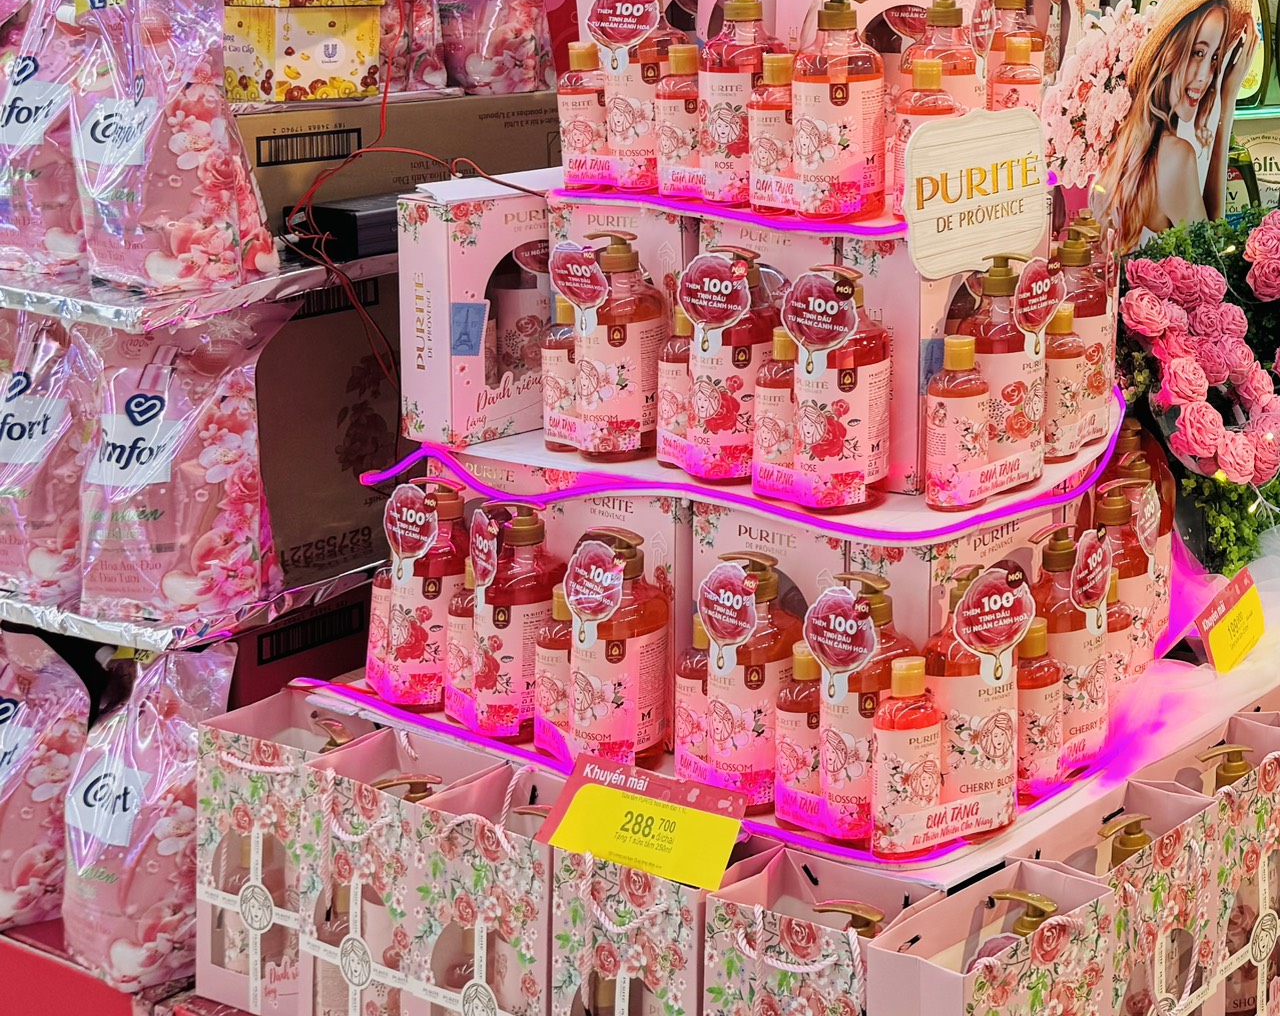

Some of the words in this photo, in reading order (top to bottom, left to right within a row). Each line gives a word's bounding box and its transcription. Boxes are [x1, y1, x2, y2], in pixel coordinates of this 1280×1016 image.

[615, 2, 654, 16] 100%
[228, 44, 241, 53] Cao
[242, 44, 255, 54] Cấp
[619, 149, 655, 158] BLOSSOM
[714, 162, 735, 170] ROSE
[392, 175, 409, 185] Đào
[411, 173, 427, 182] Anh
[914, 150, 1041, 211] PURITÉ
[936, 215, 953, 233] DE
[702, 277, 742, 294] 100%
[727, 303, 742, 311] HOA
[807, 296, 849, 315] 100%
[833, 324, 849, 333] HOA
[477, 377, 514, 414] Dành
[465, 412, 488, 432] tặng
[694, 436, 711, 446] ROSE
[800, 463, 817, 472] ROSE
[401, 507, 434, 526] 100%
[737, 523, 797, 548] PURITÉ
[1007, 571, 1023, 582] MỚI
[717, 588, 751, 610] 100%
[981, 589, 1024, 613] 100%
[829, 614, 867, 635] 100%
[1011, 613, 1029, 626] HOA
[1202, 610, 1218, 632] Khuyến
[854, 644, 868, 654] HOA
[575, 732, 612, 742] BLOSSOM
[715, 762, 754, 773] BLOSSOM
[583, 762, 626, 787] Khuyến
[627, 777, 650, 792] mãi
[959, 781, 995, 794] CHERRY
[828, 793, 867, 805] BLOSSOM
[926, 805, 949, 829] QUÀ
[950, 801, 980, 823] TẶNG
